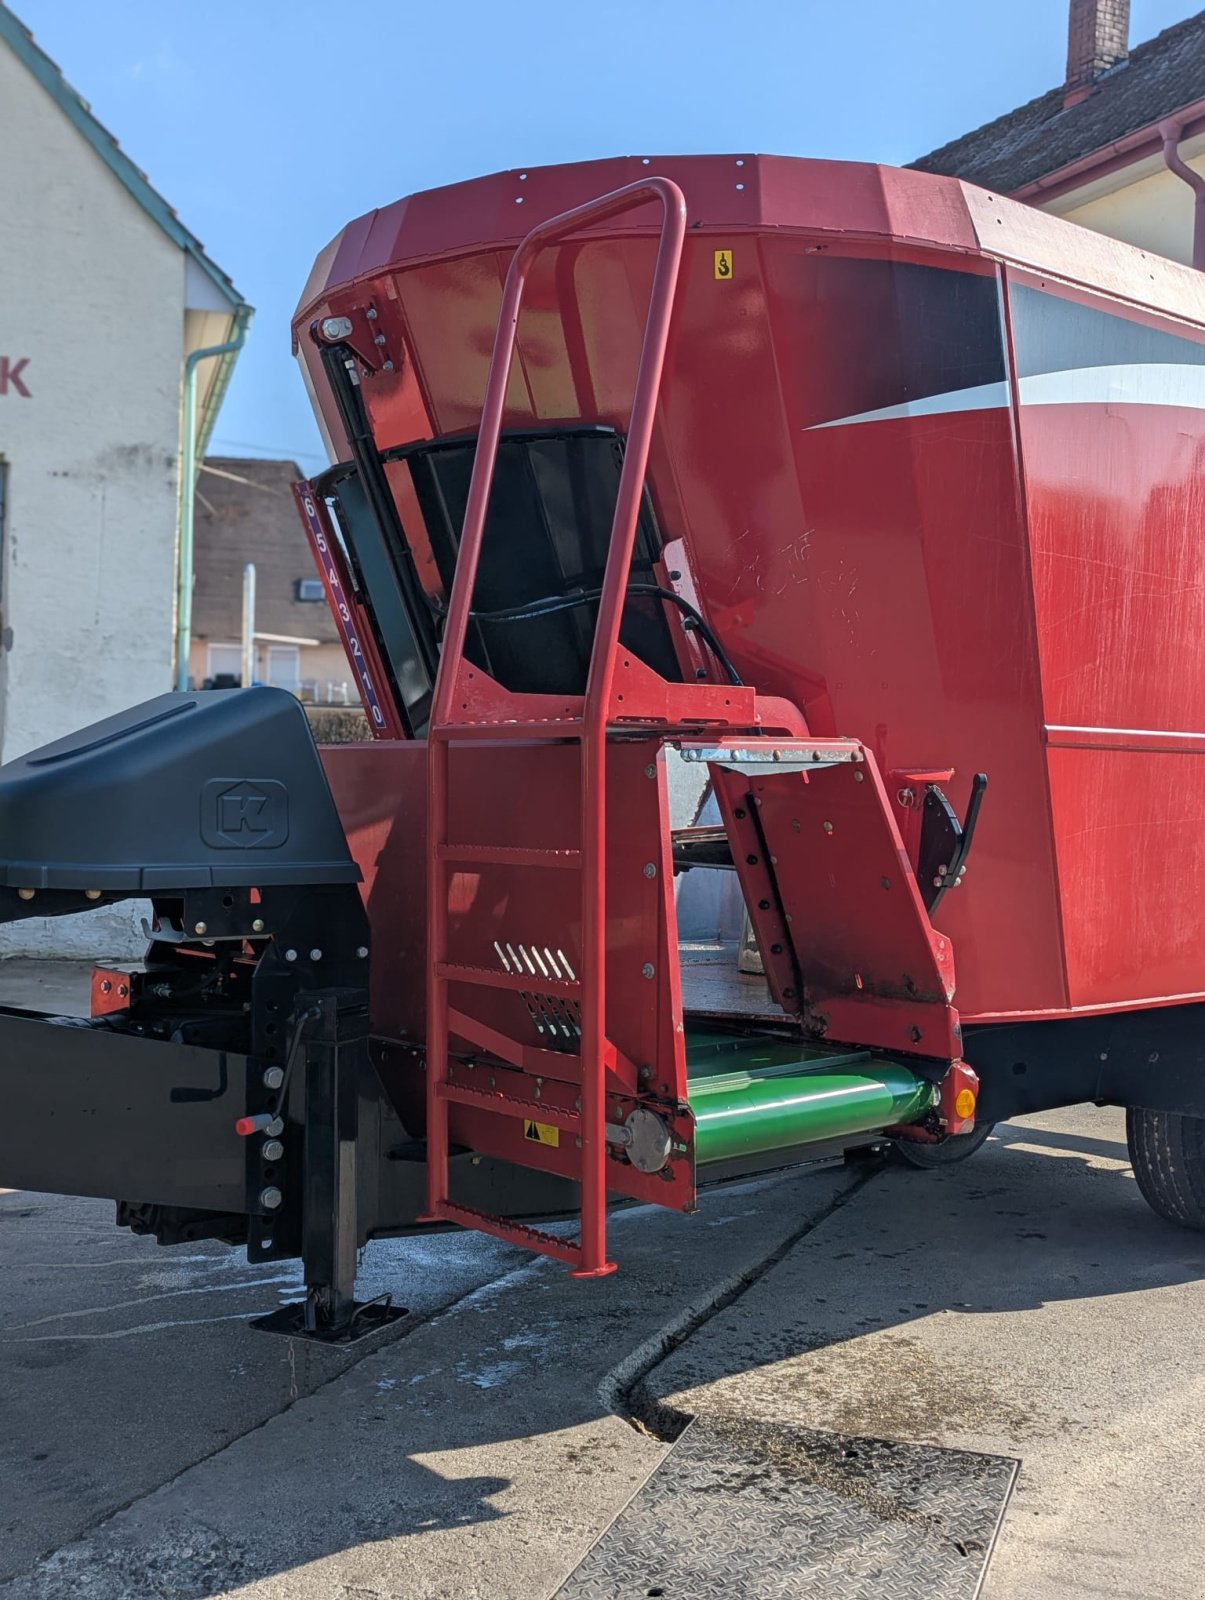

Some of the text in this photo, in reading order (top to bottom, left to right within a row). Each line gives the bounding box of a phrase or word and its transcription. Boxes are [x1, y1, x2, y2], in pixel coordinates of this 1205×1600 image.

[304, 498, 315, 517] 6
[316, 533, 327, 553] 5
[329, 568, 339, 588] 4
[339, 603, 350, 622] 3
[350, 638, 361, 656] 2
[362, 671, 372, 690] 1
[372, 705, 382, 723] 0
[221, 795, 268, 832] K
